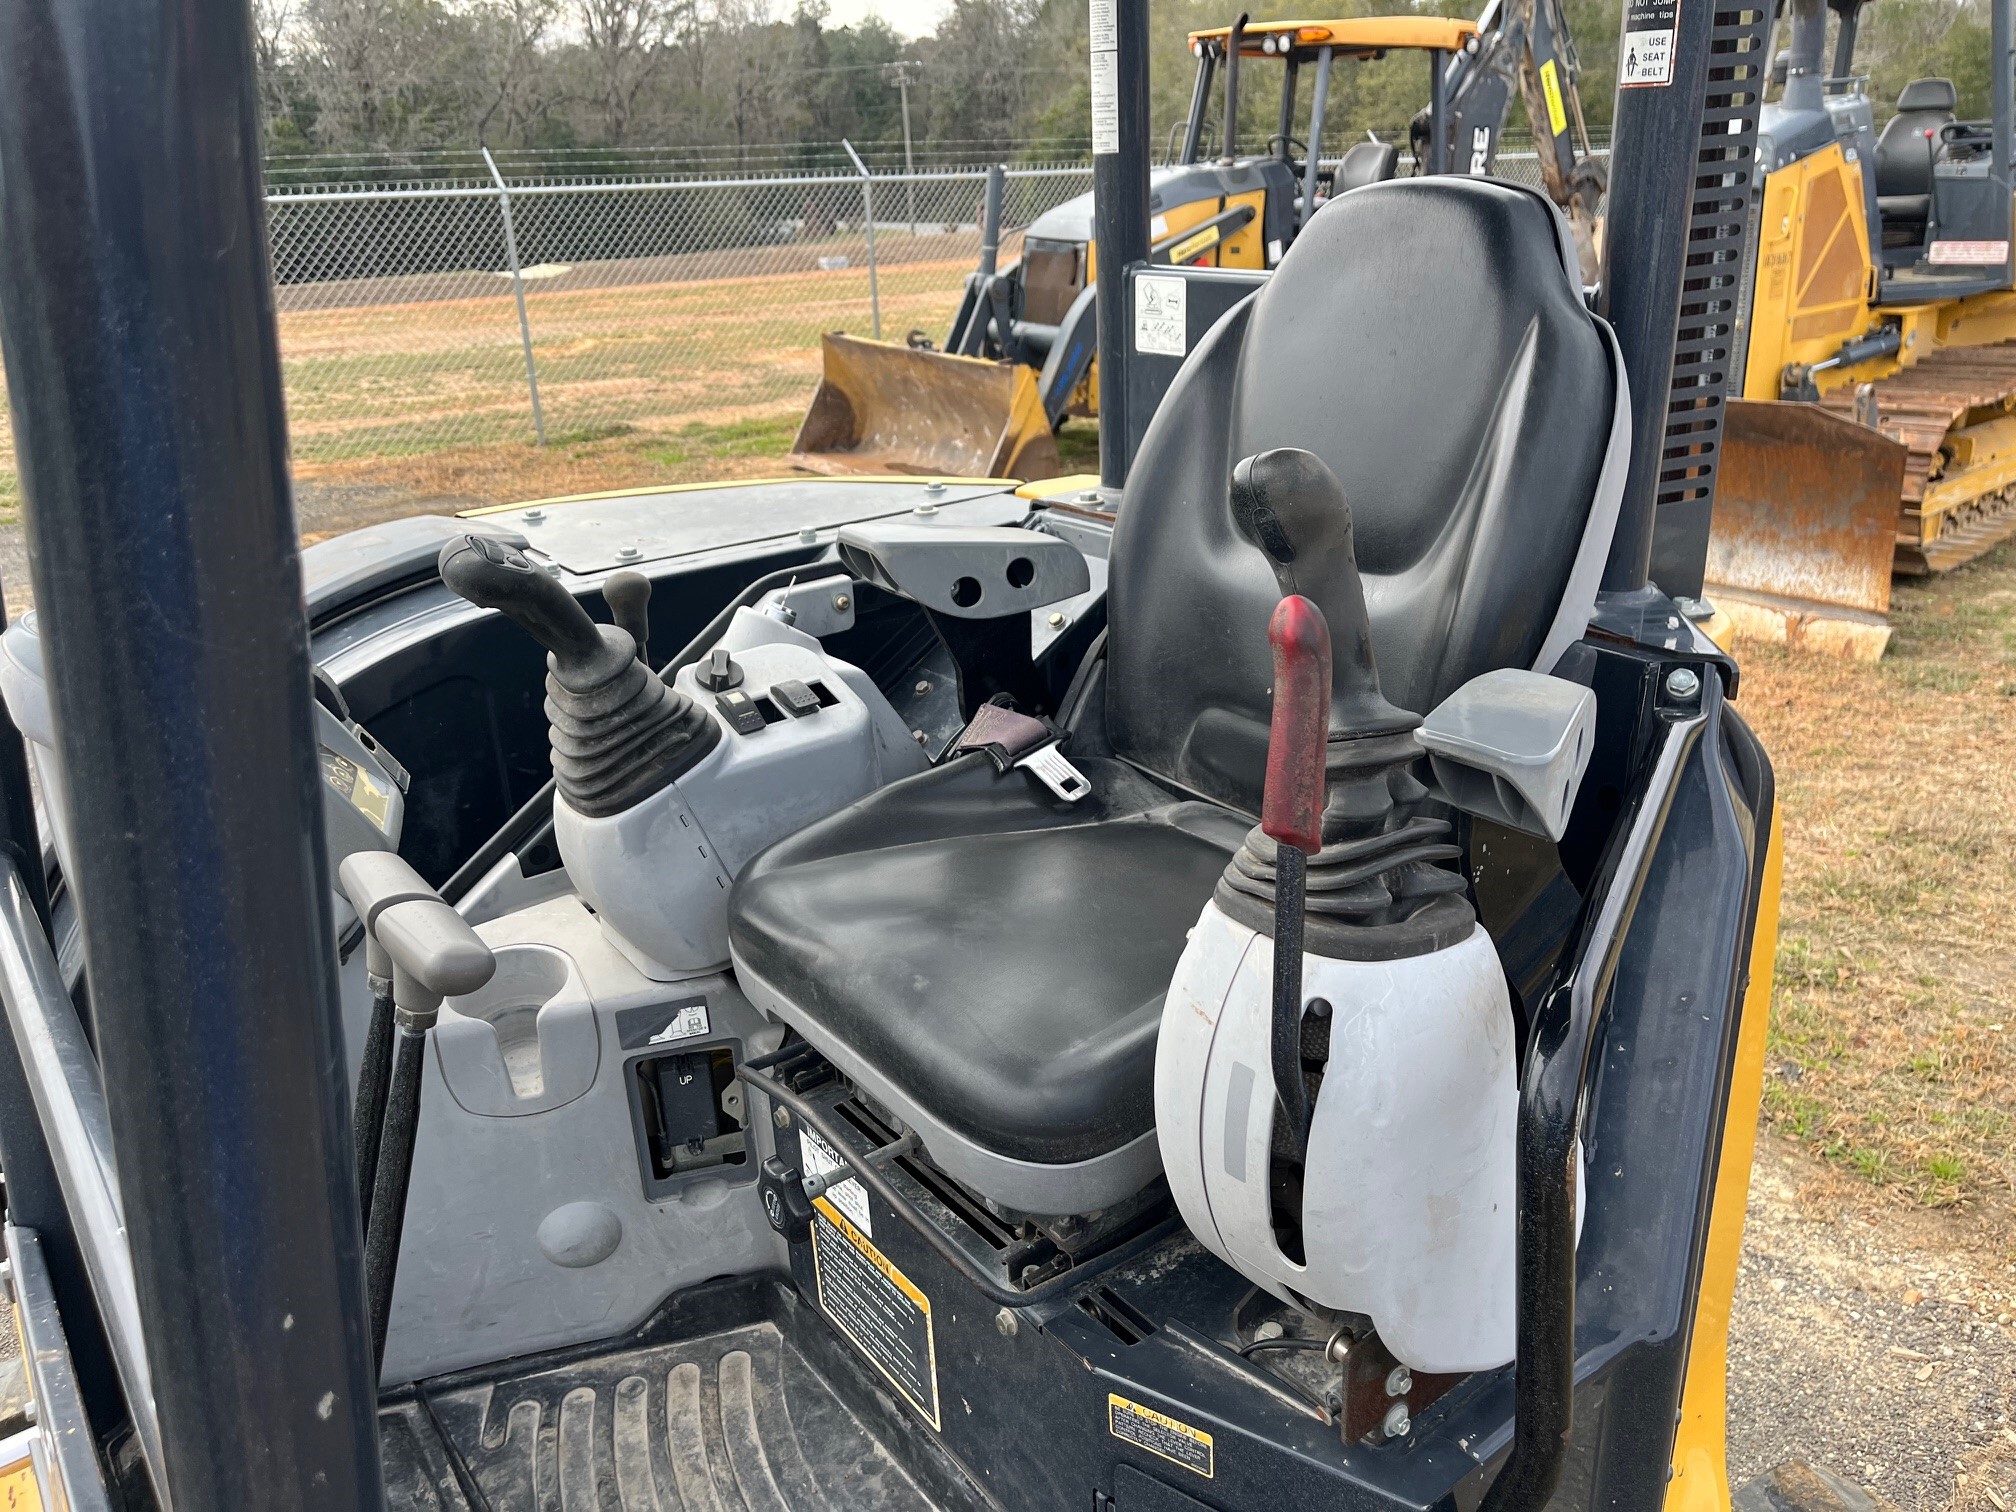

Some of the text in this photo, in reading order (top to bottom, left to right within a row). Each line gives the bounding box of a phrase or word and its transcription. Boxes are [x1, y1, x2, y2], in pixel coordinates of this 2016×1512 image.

[1631, 12, 1655, 20] machine
[1659, 11, 1674, 19] tips
[1649, 37, 1667, 46] USE
[1642, 52, 1665, 61] SEAT
[1641, 67, 1664, 76] BELT
[679, 1074, 693, 1086] UP
[807, 1126, 848, 1167] IMPORTA
[851, 1231, 889, 1275] CAUTION
[1142, 1408, 1197, 1438] CAUTION
